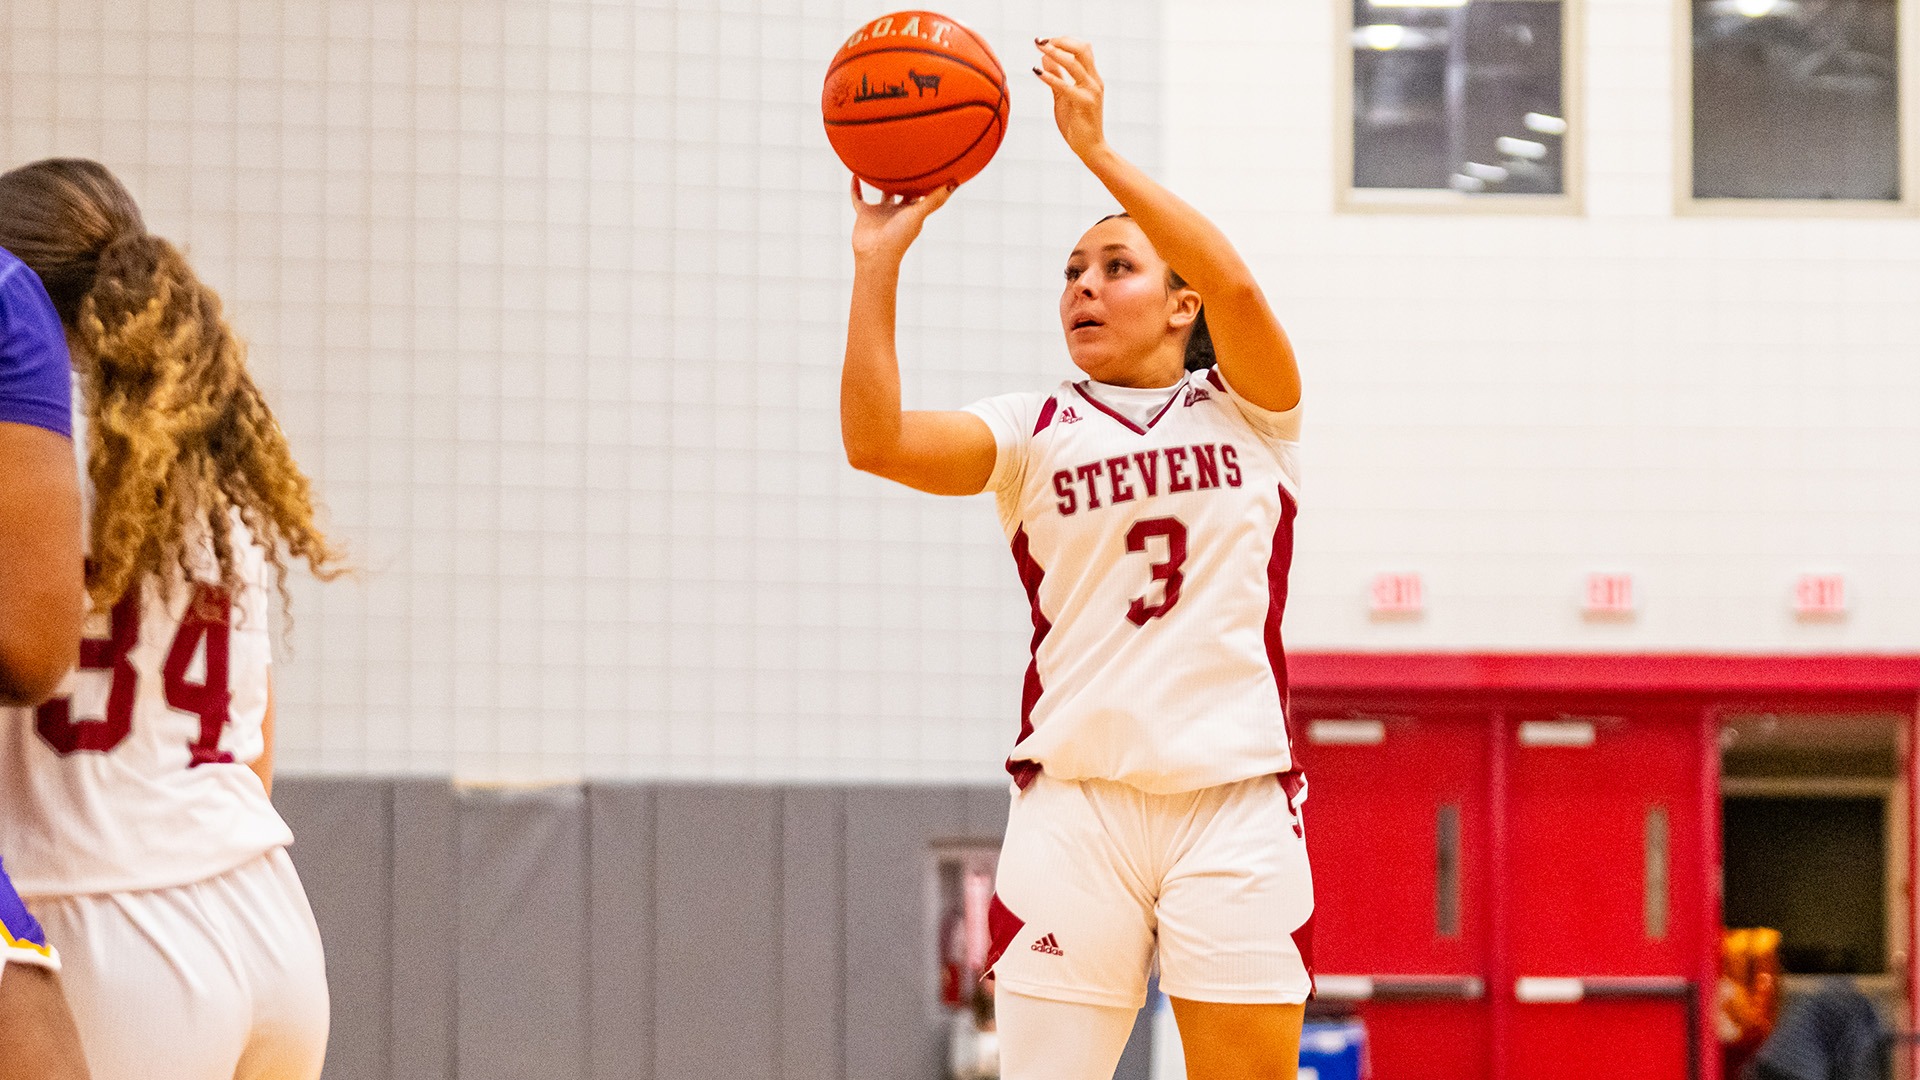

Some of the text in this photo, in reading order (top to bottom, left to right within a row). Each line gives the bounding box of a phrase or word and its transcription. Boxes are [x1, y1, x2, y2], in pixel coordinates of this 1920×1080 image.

[1052, 443, 1243, 517] STEVENS
[1124, 514, 1188, 628] 3
[35, 556, 235, 769] 34
[1031, 944, 1064, 957] adidas
